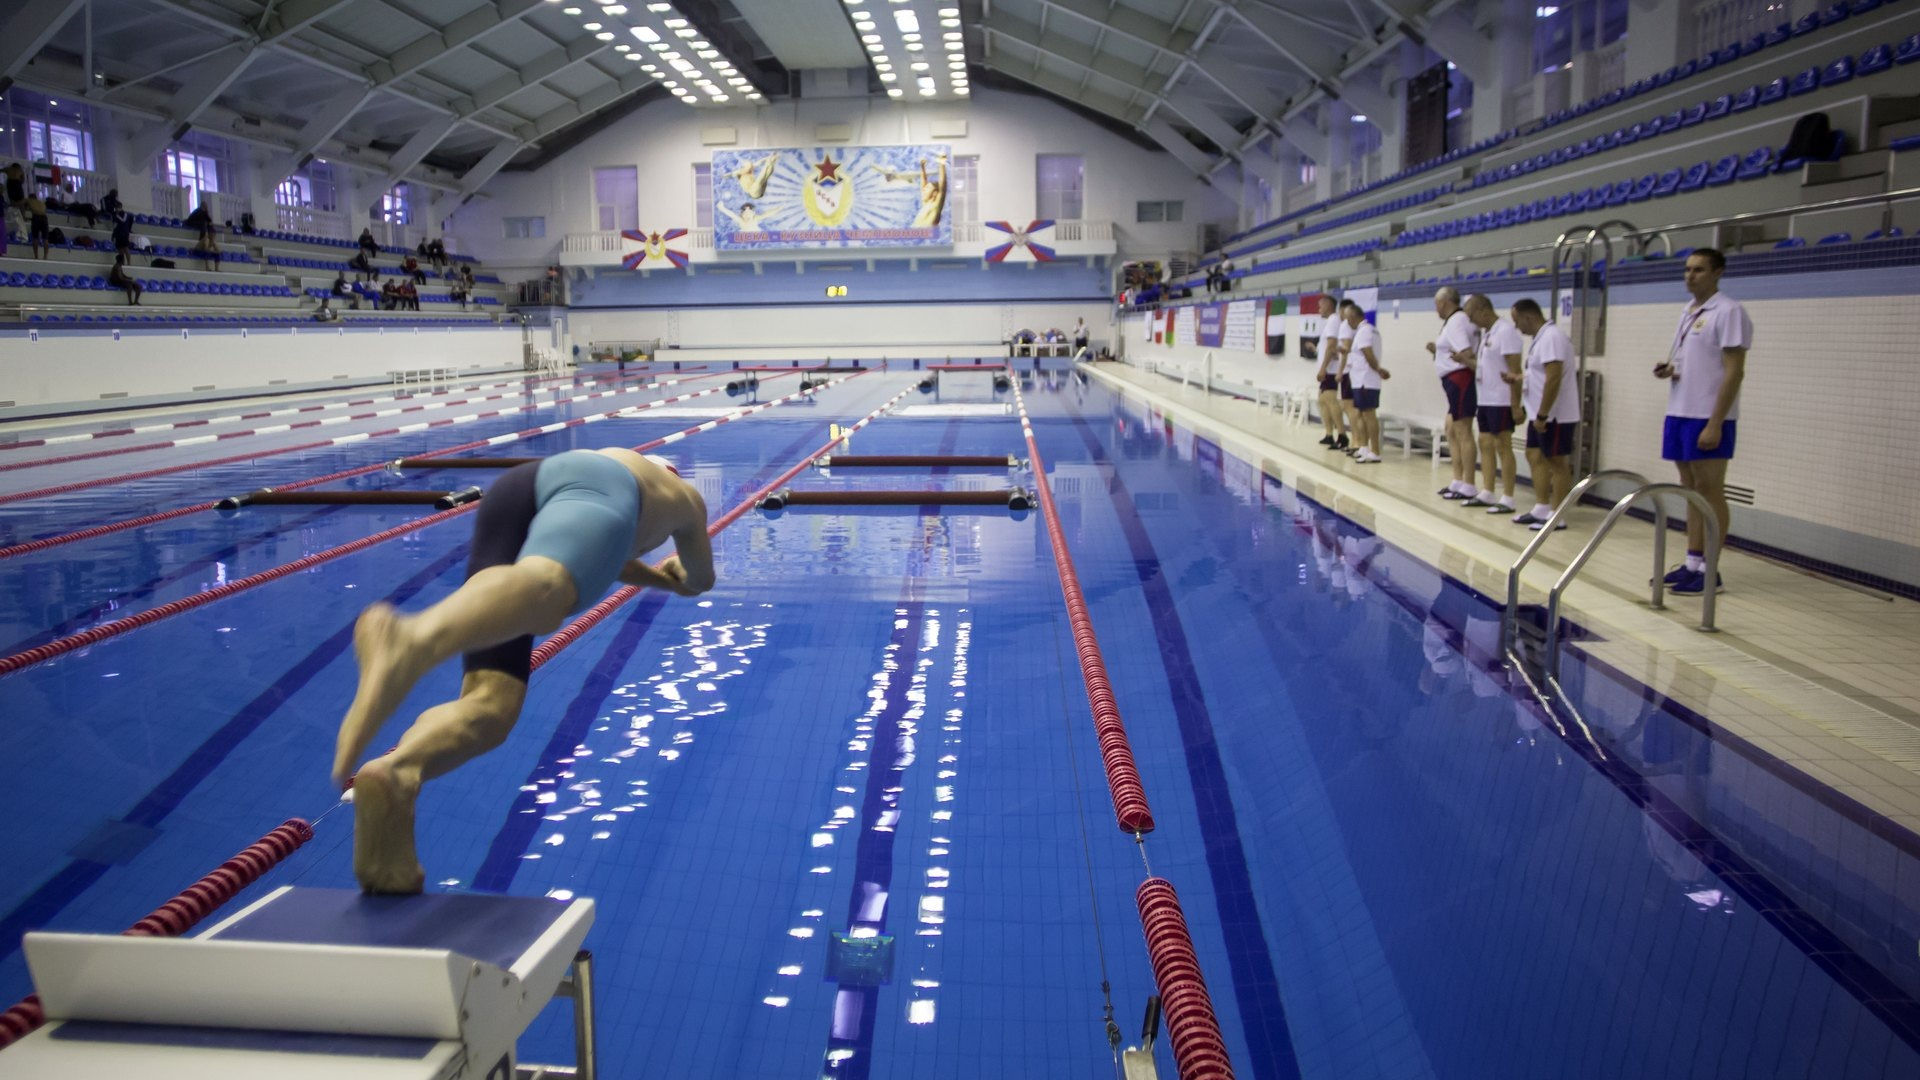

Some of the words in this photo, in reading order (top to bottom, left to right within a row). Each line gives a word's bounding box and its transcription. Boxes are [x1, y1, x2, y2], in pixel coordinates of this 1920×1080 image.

[734, 231, 769, 243] ЦСКА
[1561, 296, 1572, 316] 16
[30, 332, 38, 342] 11
